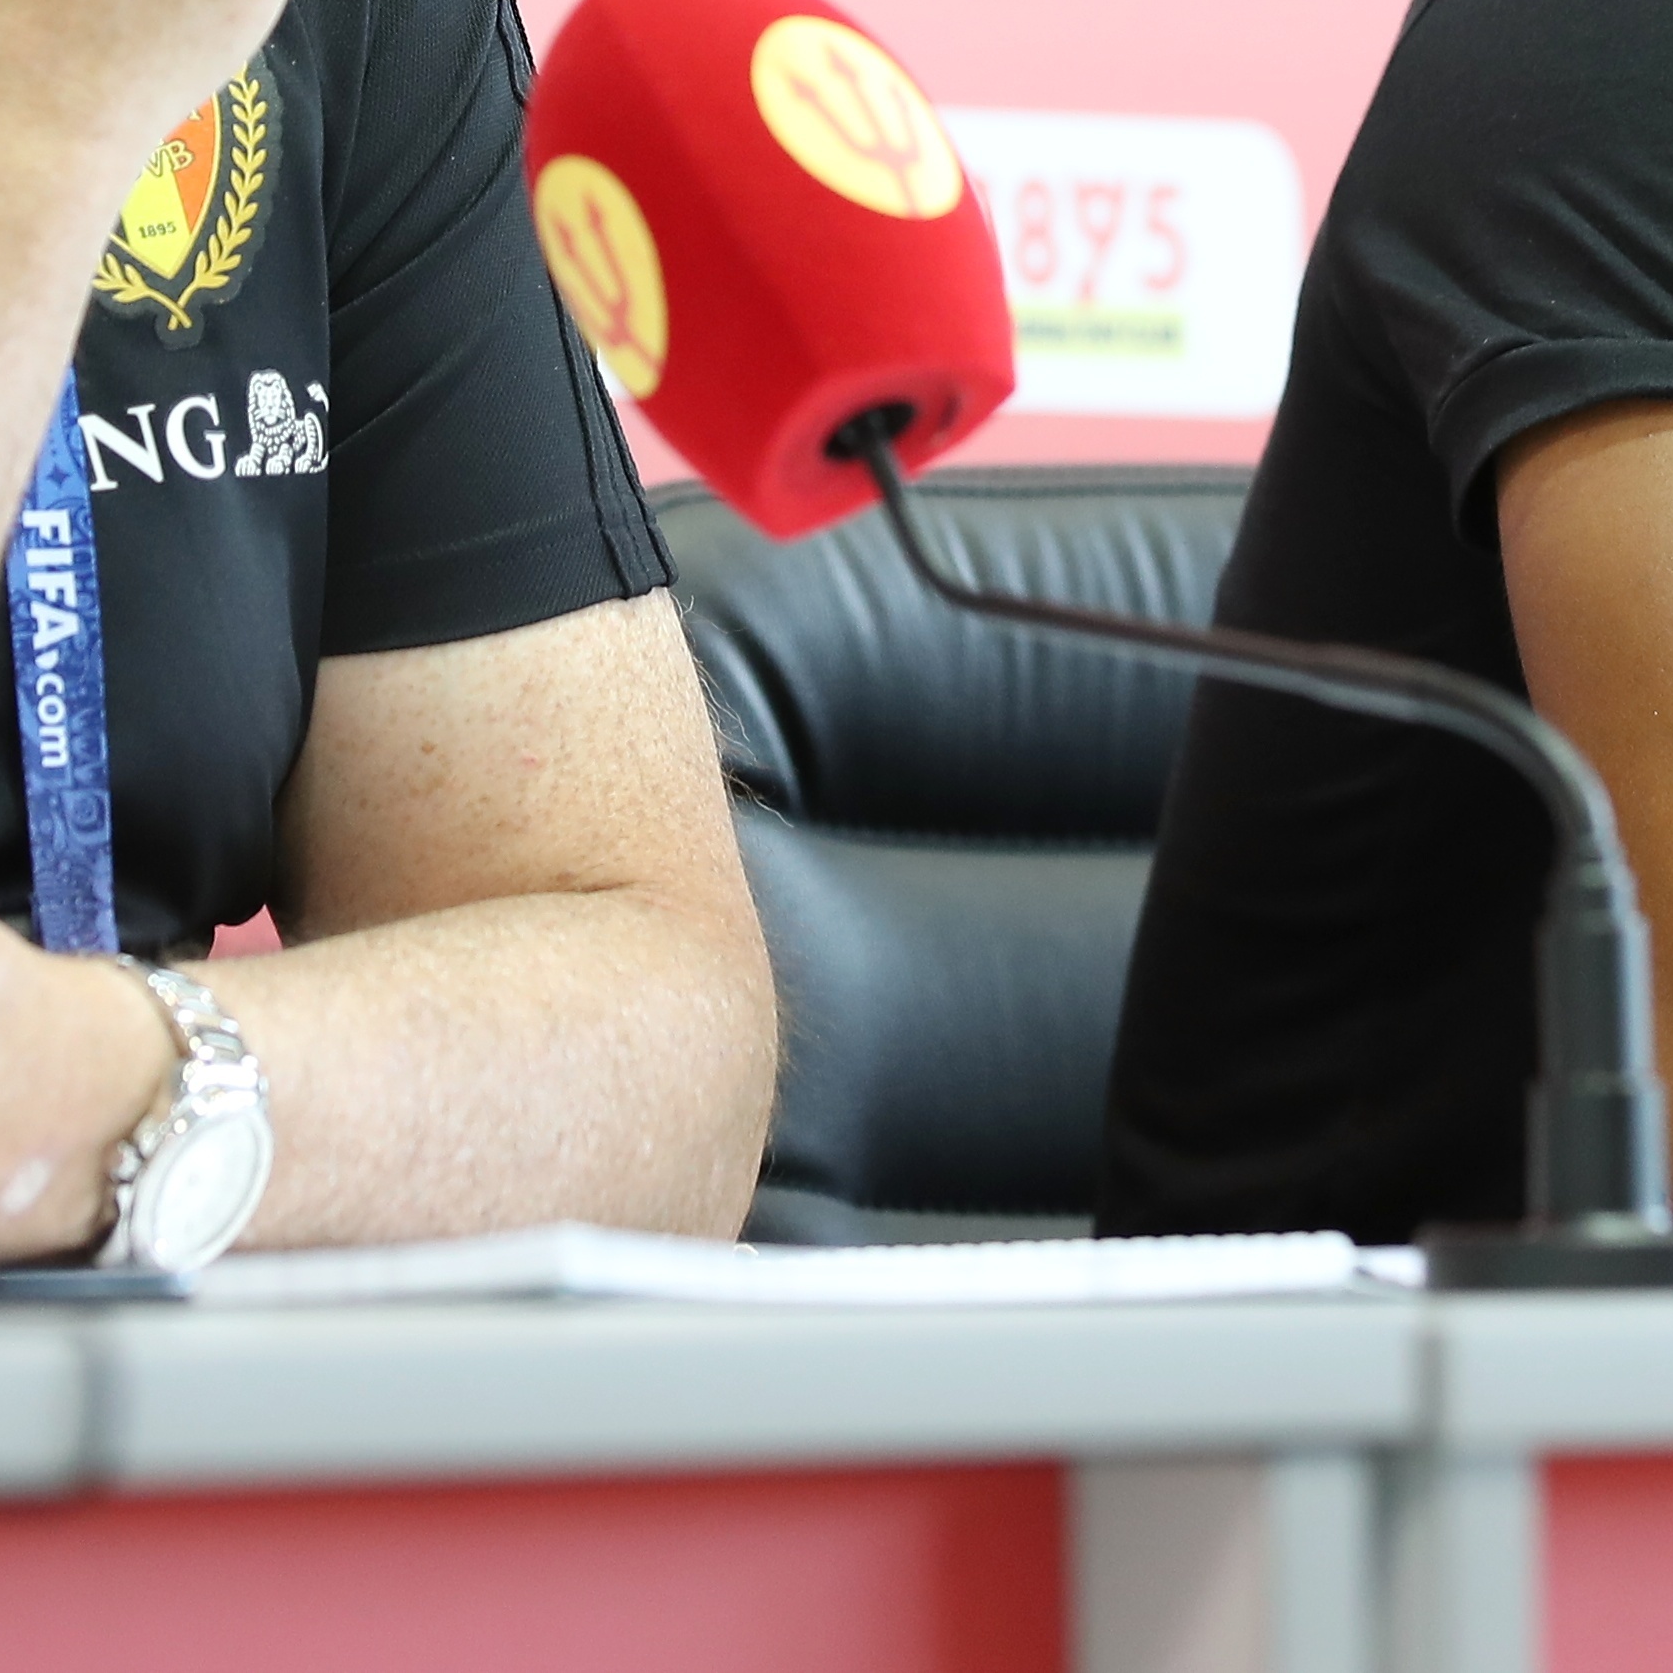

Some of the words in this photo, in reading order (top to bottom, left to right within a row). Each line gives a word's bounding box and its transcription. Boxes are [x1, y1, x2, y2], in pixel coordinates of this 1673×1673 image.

[138, 220, 178, 240] 1895
[976, 176, 1188, 308] 895
[78, 392, 226, 492] NG
